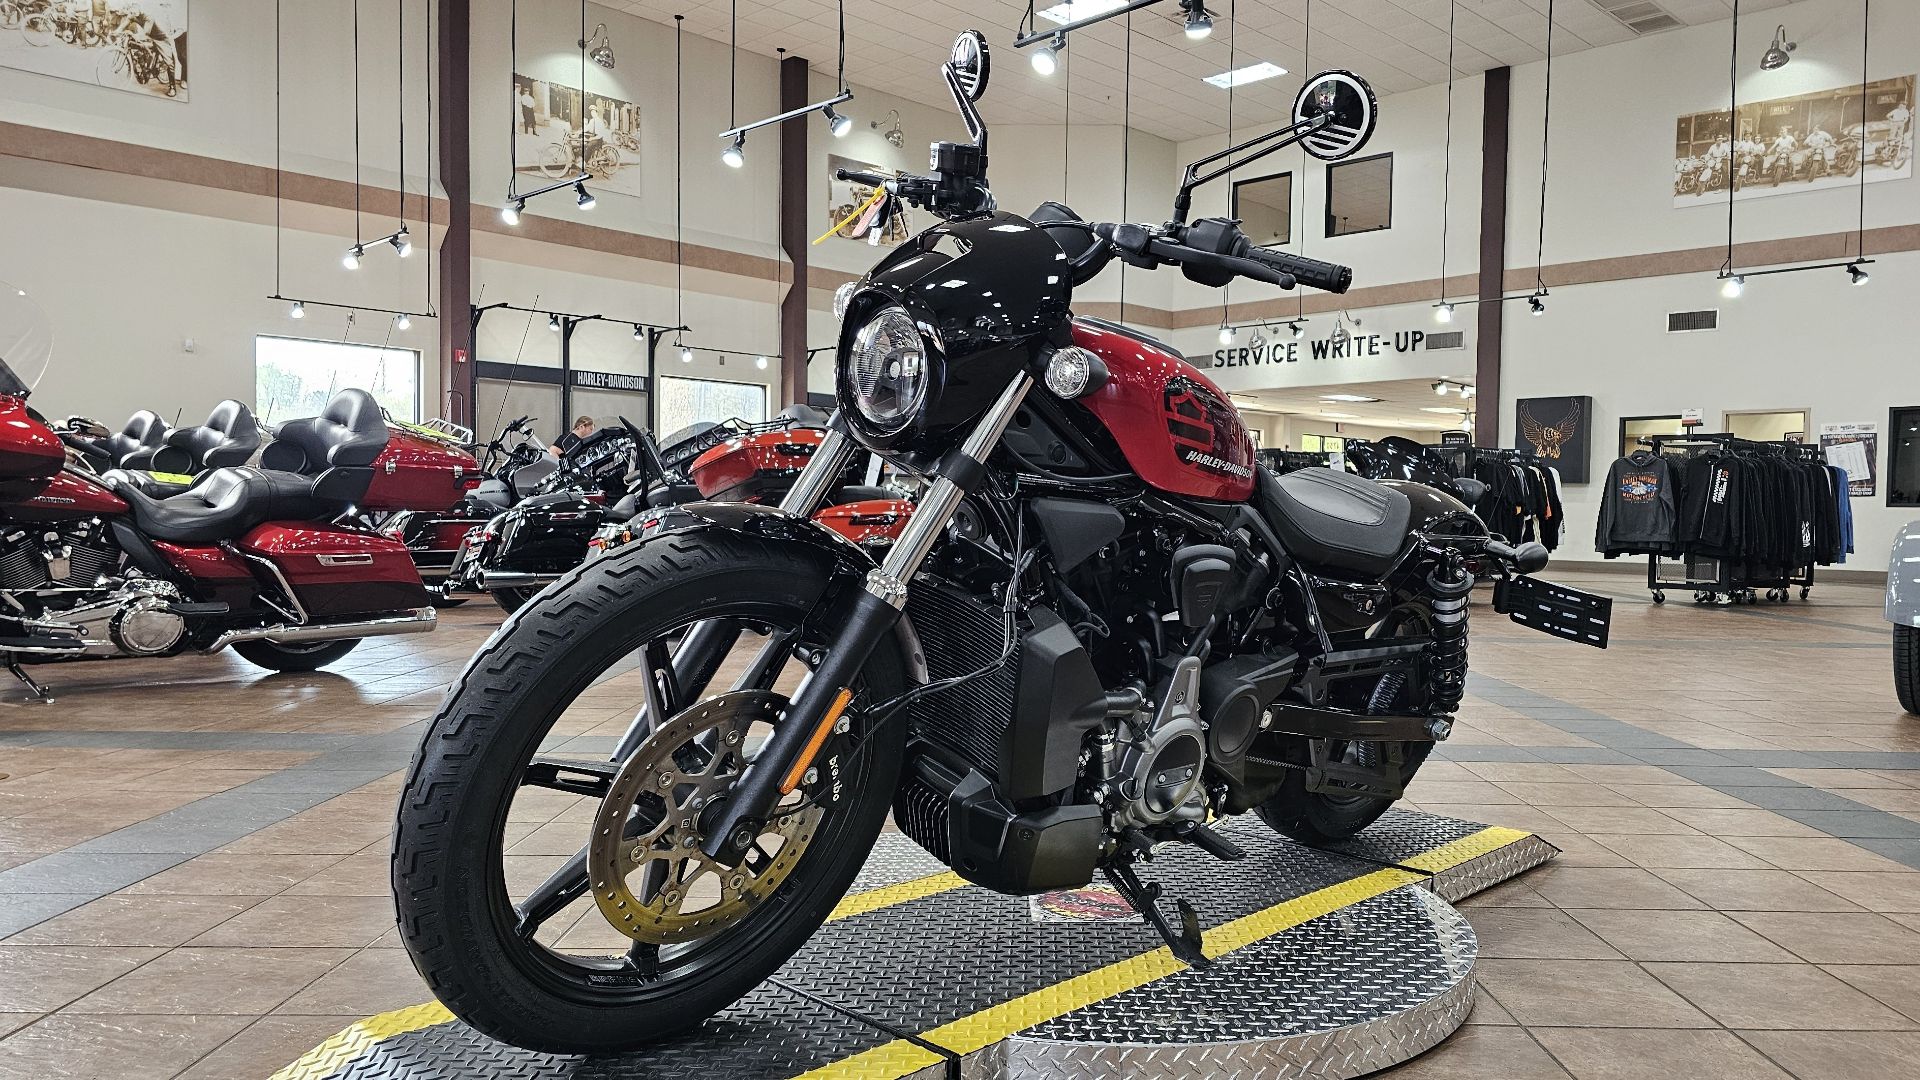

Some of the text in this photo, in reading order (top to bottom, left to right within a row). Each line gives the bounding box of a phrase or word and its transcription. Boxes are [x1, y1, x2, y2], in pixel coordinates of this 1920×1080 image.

[1214, 330, 1425, 368] SERVICE WRITE-UP
[577, 371, 645, 390] HARLEY-DAVIDSON
